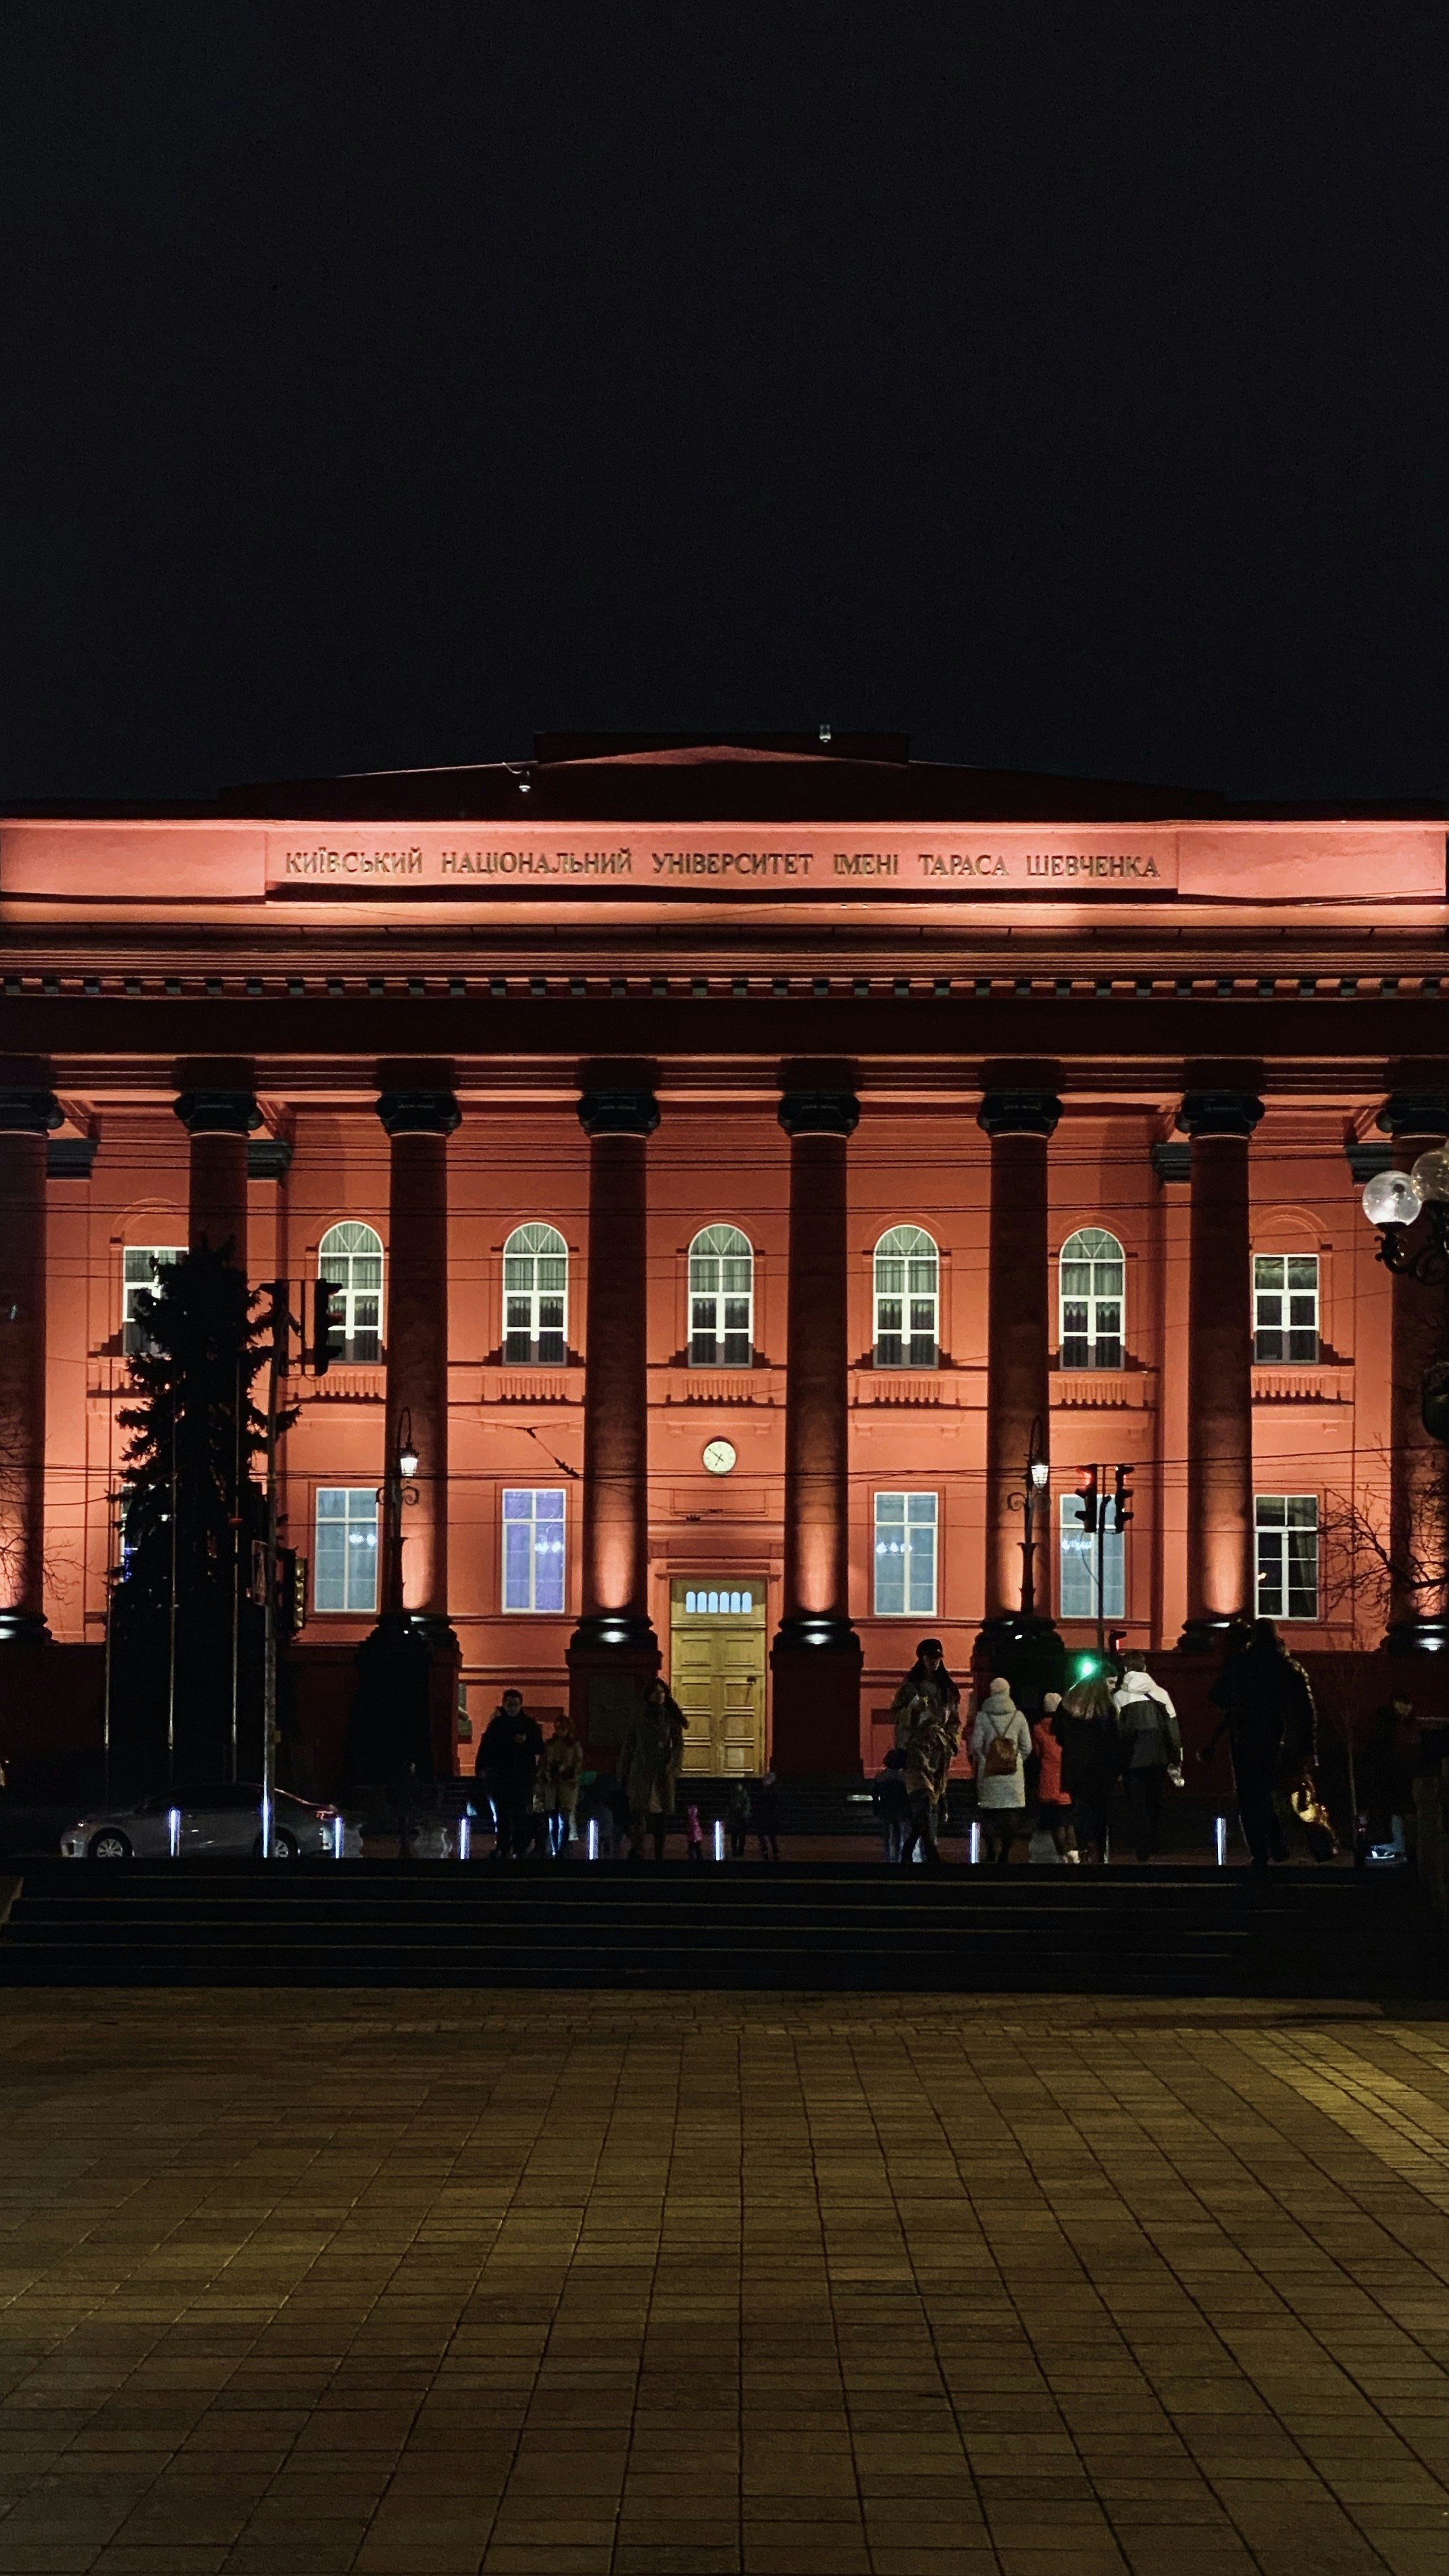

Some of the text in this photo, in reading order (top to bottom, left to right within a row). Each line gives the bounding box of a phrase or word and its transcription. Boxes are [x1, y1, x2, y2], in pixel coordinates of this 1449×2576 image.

[286, 846, 1161, 877] КИЇВСЬКИЙ НАЦІОНАЛЬНИЙ УНІВЕРСИТЕТ ІМЕНІ ТАРАСА ШЕВЧЕНКА
